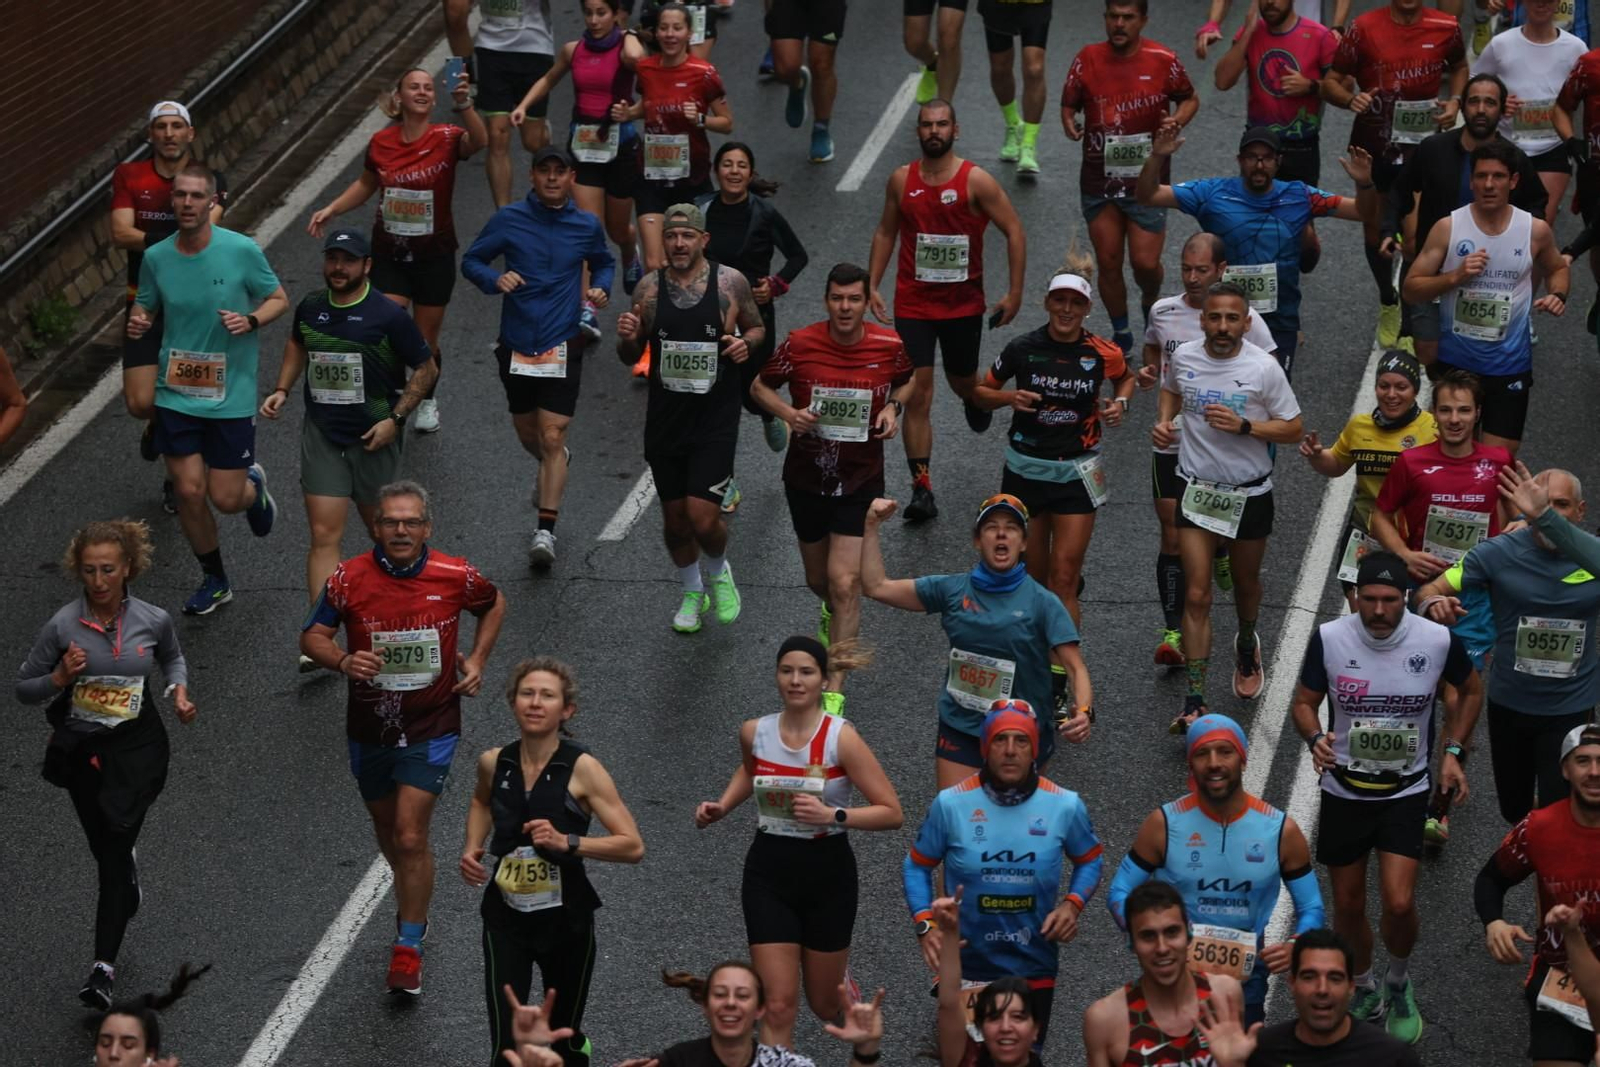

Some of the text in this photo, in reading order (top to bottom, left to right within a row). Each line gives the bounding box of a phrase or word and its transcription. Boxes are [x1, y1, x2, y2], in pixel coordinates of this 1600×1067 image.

[1113, 146, 1144, 161] 8262
[924, 247, 957, 261] 7915
[1461, 301, 1496, 319] 7654
[176, 363, 210, 380] 5861
[665, 354, 708, 371] 10255
[315, 363, 349, 382] 9135
[821, 401, 857, 419] 9692
[1192, 490, 1231, 511] 8760
[1435, 520, 1476, 542] 7537
[1527, 631, 1570, 652] 9557
[383, 646, 424, 665] 9579
[959, 664, 998, 690] 6857
[1359, 732, 1403, 751] 9030
[981, 850, 1036, 863] KIA
[1197, 878, 1252, 893] KIA
[981, 896, 1032, 908] Genacol
[1193, 942, 1240, 967] 5636
